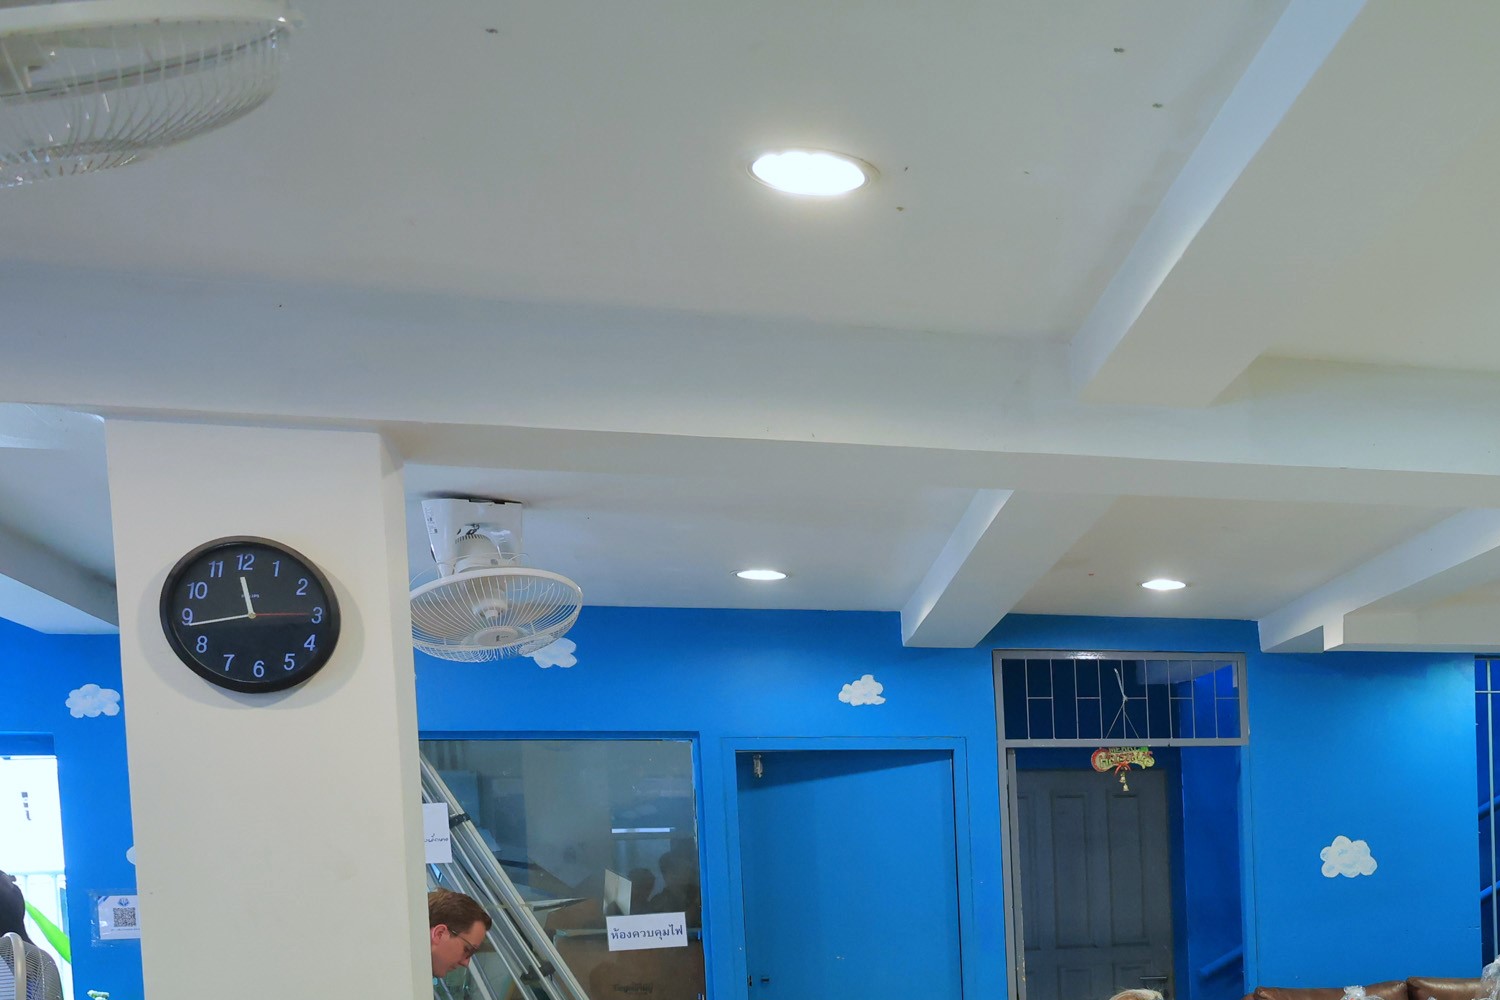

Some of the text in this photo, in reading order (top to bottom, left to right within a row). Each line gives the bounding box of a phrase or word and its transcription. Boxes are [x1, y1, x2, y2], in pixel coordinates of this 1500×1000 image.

[208, 561, 225, 578] 11
[236, 554, 255, 571] 12
[272, 560, 281, 577] 1
[187, 581, 208, 599] 10
[296, 578, 309, 596] 2
[181, 608, 194, 626] 9
[311, 607, 323, 624] 3
[196, 636, 208, 653] 8
[303, 634, 316, 651] 4
[223, 654, 235, 671] 7
[252, 660, 265, 678] 6
[283, 653, 296, 670] 5
[610, 924, 684, 940] ห้องควบคุมไฟ
